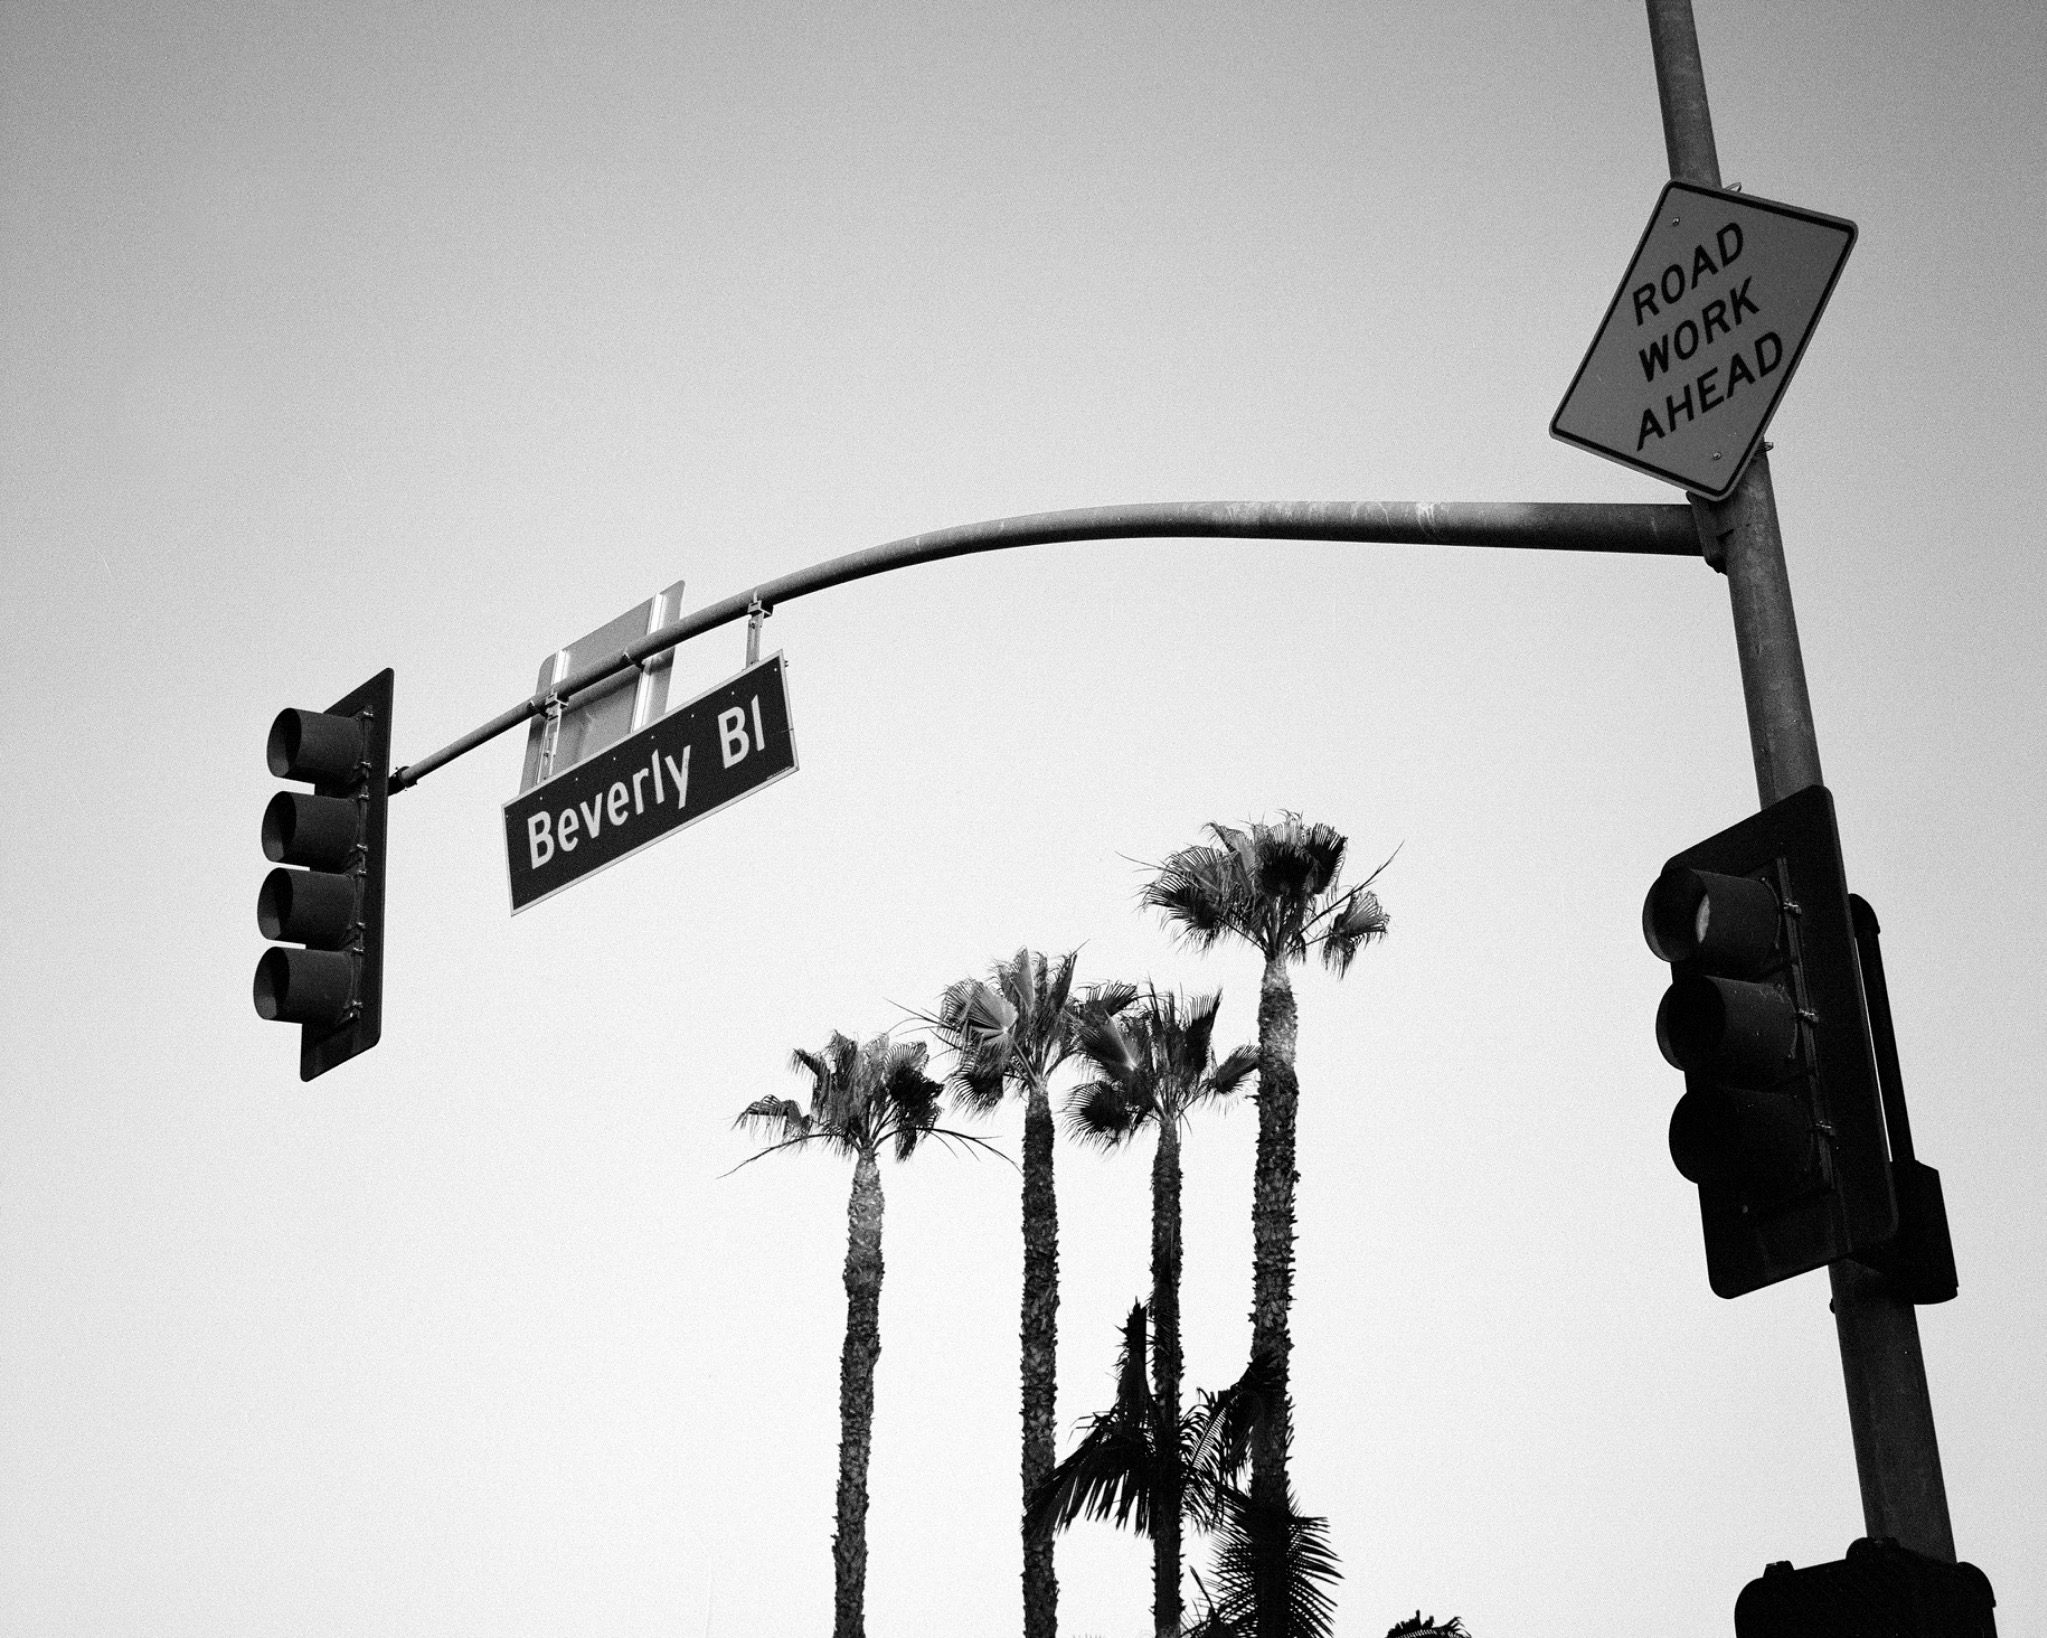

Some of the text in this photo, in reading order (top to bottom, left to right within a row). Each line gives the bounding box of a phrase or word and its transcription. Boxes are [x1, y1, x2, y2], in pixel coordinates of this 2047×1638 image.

[1633, 222, 1743, 326] ROAD
[1638, 275, 1760, 382] WORK
[1636, 331, 1783, 451] AHEAD
[527, 694, 765, 870] Beverly Bl
